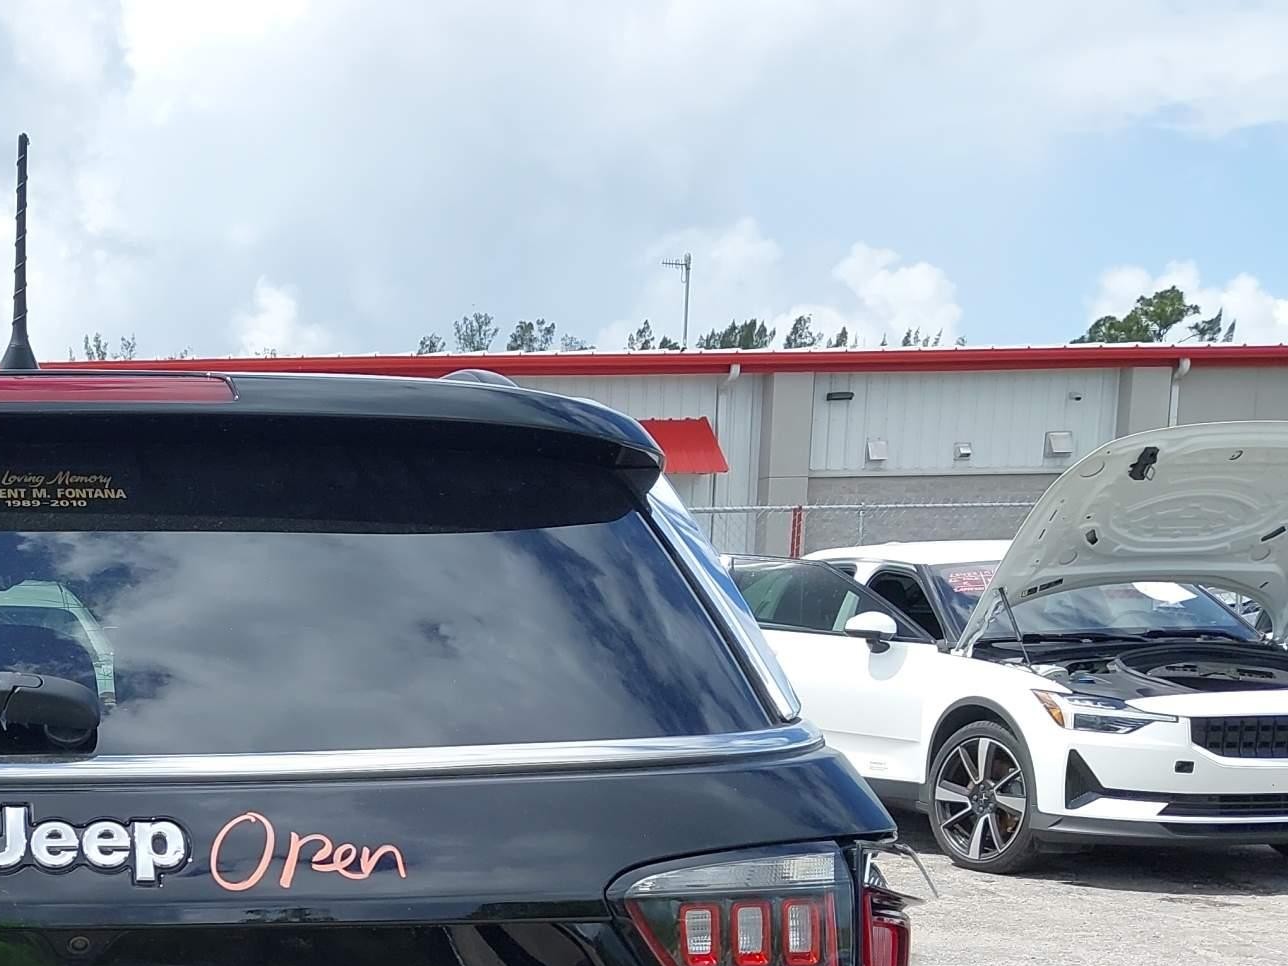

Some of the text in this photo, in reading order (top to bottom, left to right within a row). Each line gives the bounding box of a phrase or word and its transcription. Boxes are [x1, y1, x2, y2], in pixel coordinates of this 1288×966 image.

[1, 470, 44, 488] Loving
[46, 471, 112, 489] Memory
[32, 488, 51, 499] M.
[57, 488, 127, 499] FONTANA
[4, 499, 88, 508] 1989-2010
